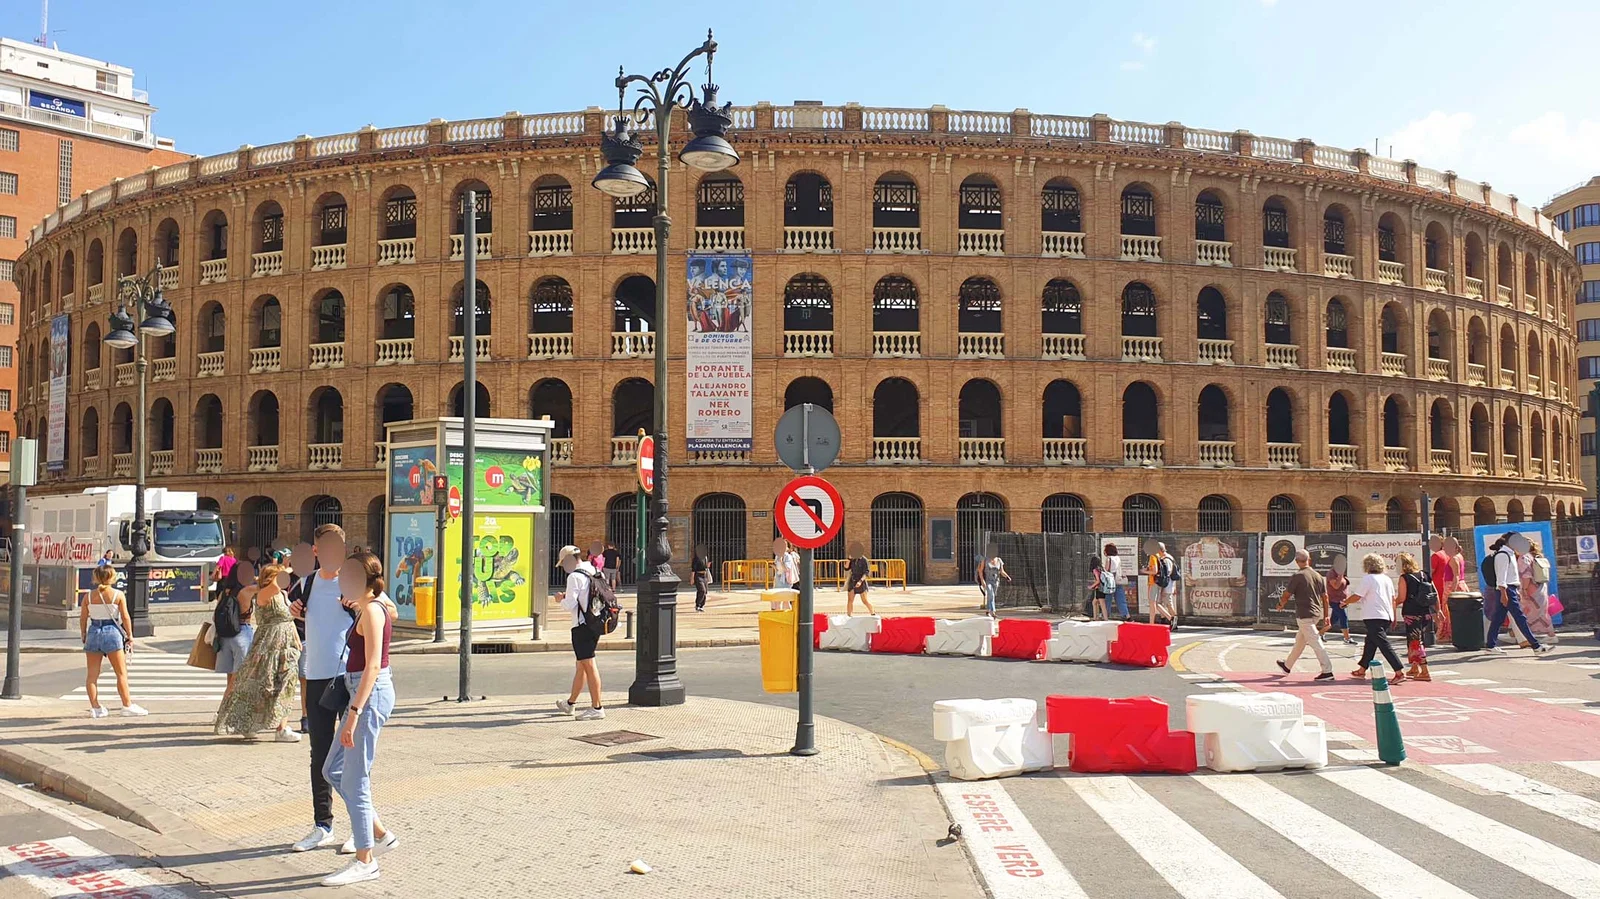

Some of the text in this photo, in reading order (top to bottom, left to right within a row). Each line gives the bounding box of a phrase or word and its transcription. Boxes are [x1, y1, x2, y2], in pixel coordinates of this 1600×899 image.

[1352, 539, 1385, 549] Gracias
[1386, 541, 1402, 549] por
[1403, 538, 1422, 547] cuid
[961, 793, 1014, 833] ESPERE
